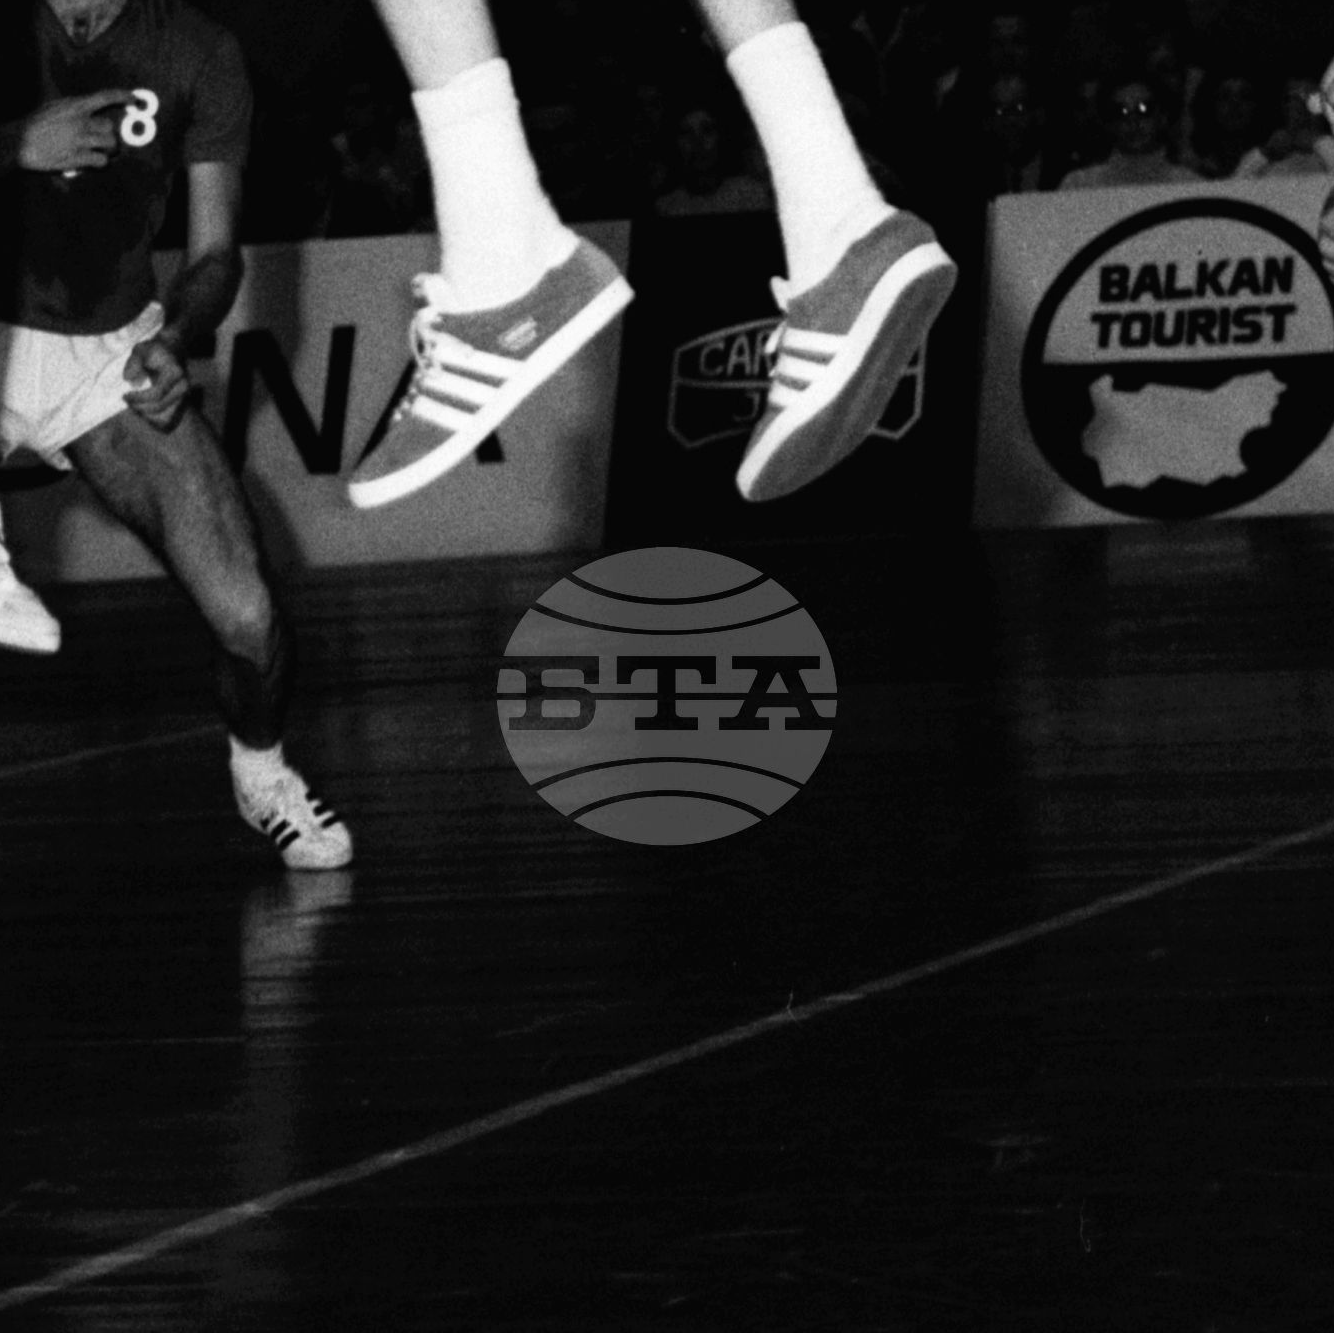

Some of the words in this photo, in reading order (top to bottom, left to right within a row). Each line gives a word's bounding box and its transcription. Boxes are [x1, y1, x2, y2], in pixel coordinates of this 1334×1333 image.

[120, 87, 160, 148] 8
[1099, 256, 1294, 303] BALKAN
[1091, 304, 1296, 348] TOURIST
